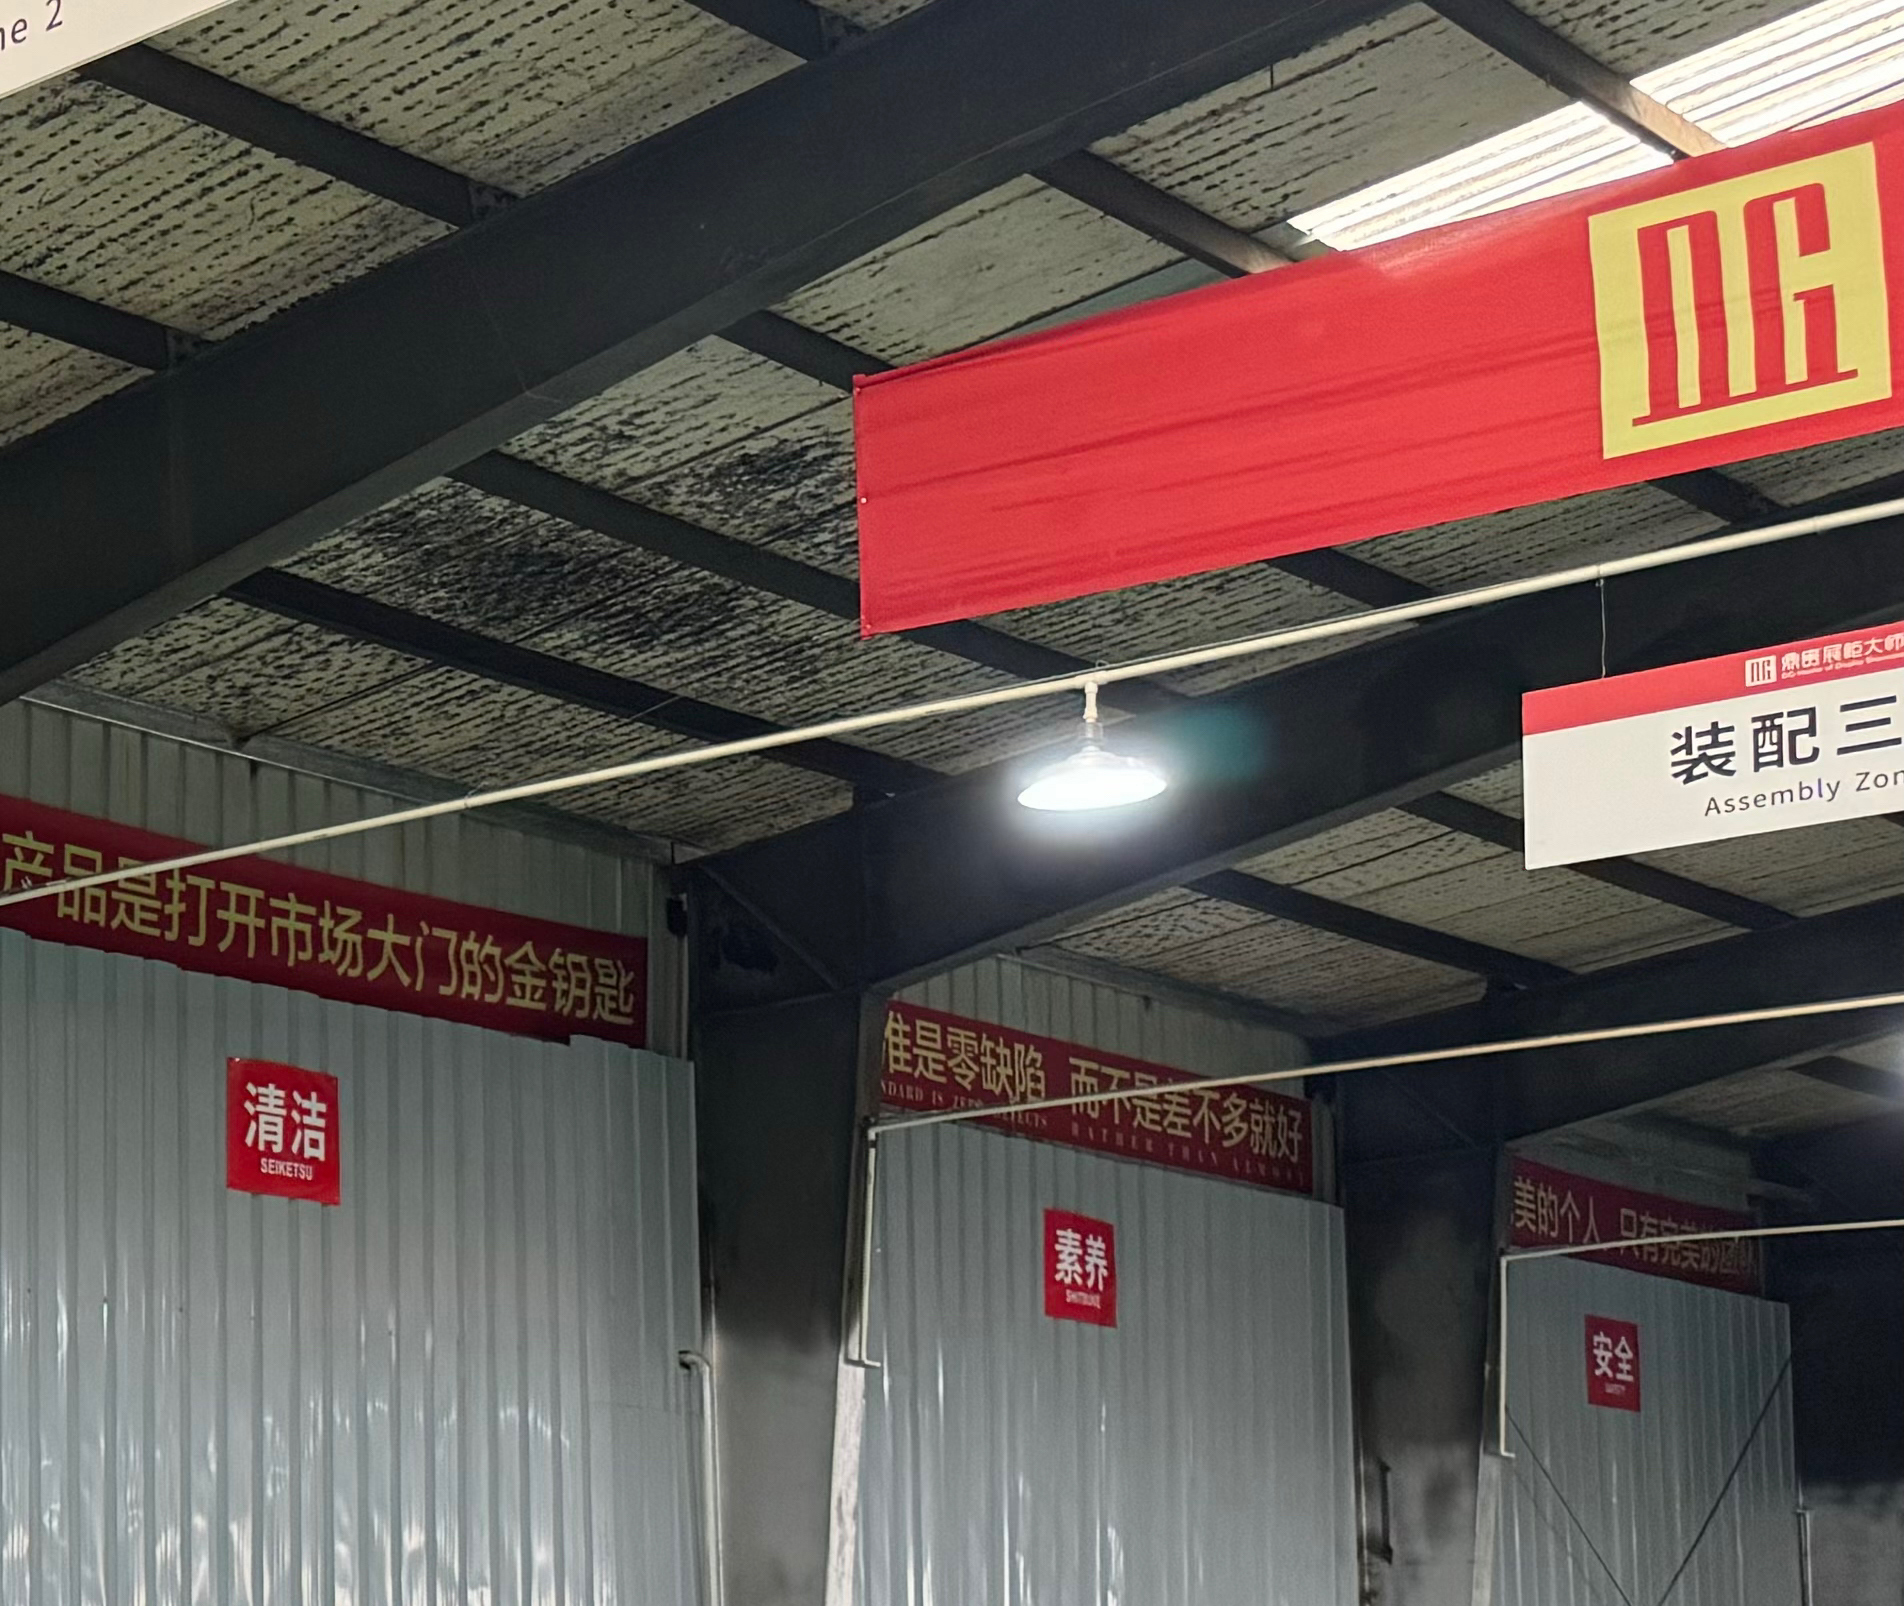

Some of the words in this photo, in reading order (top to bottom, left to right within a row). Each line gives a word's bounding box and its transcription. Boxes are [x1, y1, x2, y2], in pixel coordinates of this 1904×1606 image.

[45, 0, 64, 32] 2
[1670, 695, 1902, 785] 装配三
[1704, 777, 1841, 817] Assembly
[244, 1082, 326, 1161] 清洁
[1069, 1056, 1303, 1163] 而不是差不多就好
[260, 1157, 314, 1181] SEIKETSU
[1055, 1228, 1108, 1292] 素养
[1593, 1330, 1634, 1382] 安全
